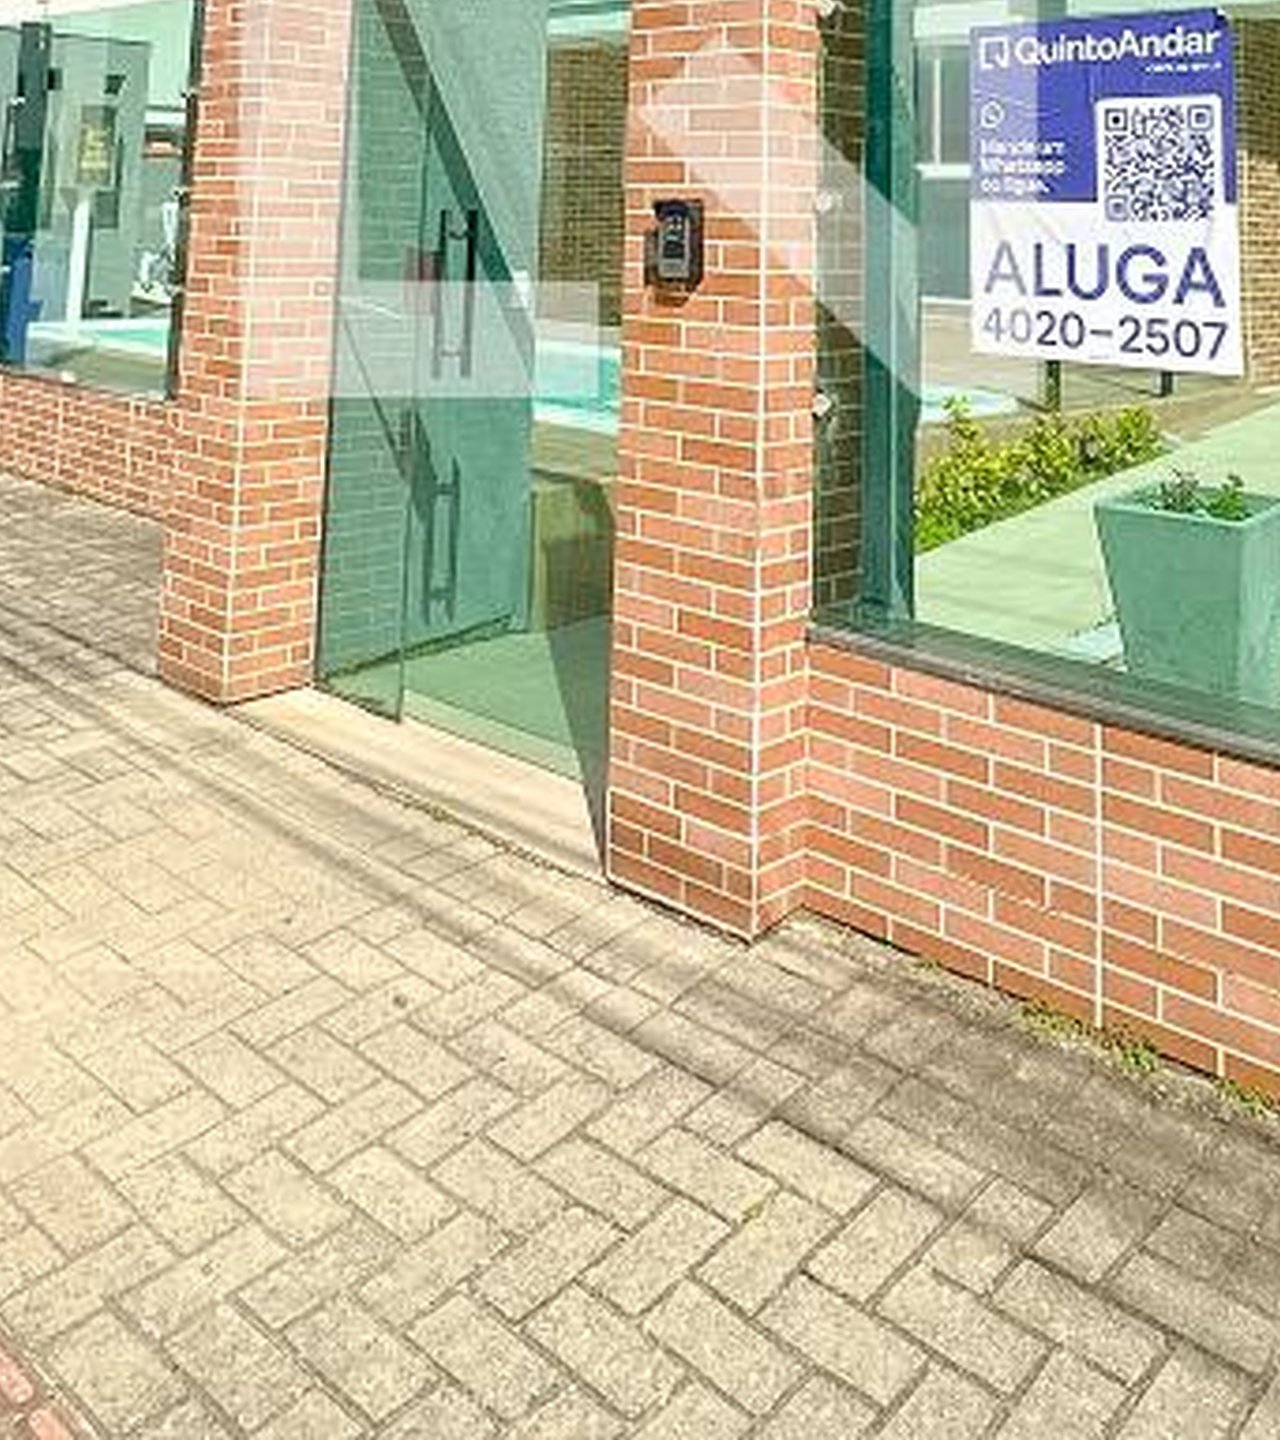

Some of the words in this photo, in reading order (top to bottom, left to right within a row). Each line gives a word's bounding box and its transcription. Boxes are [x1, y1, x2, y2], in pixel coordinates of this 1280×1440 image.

[1015, 25, 1220, 64] QuintoAndar
[984, 241, 1226, 308] ALUGA
[982, 306, 1229, 360] 4020-2507
